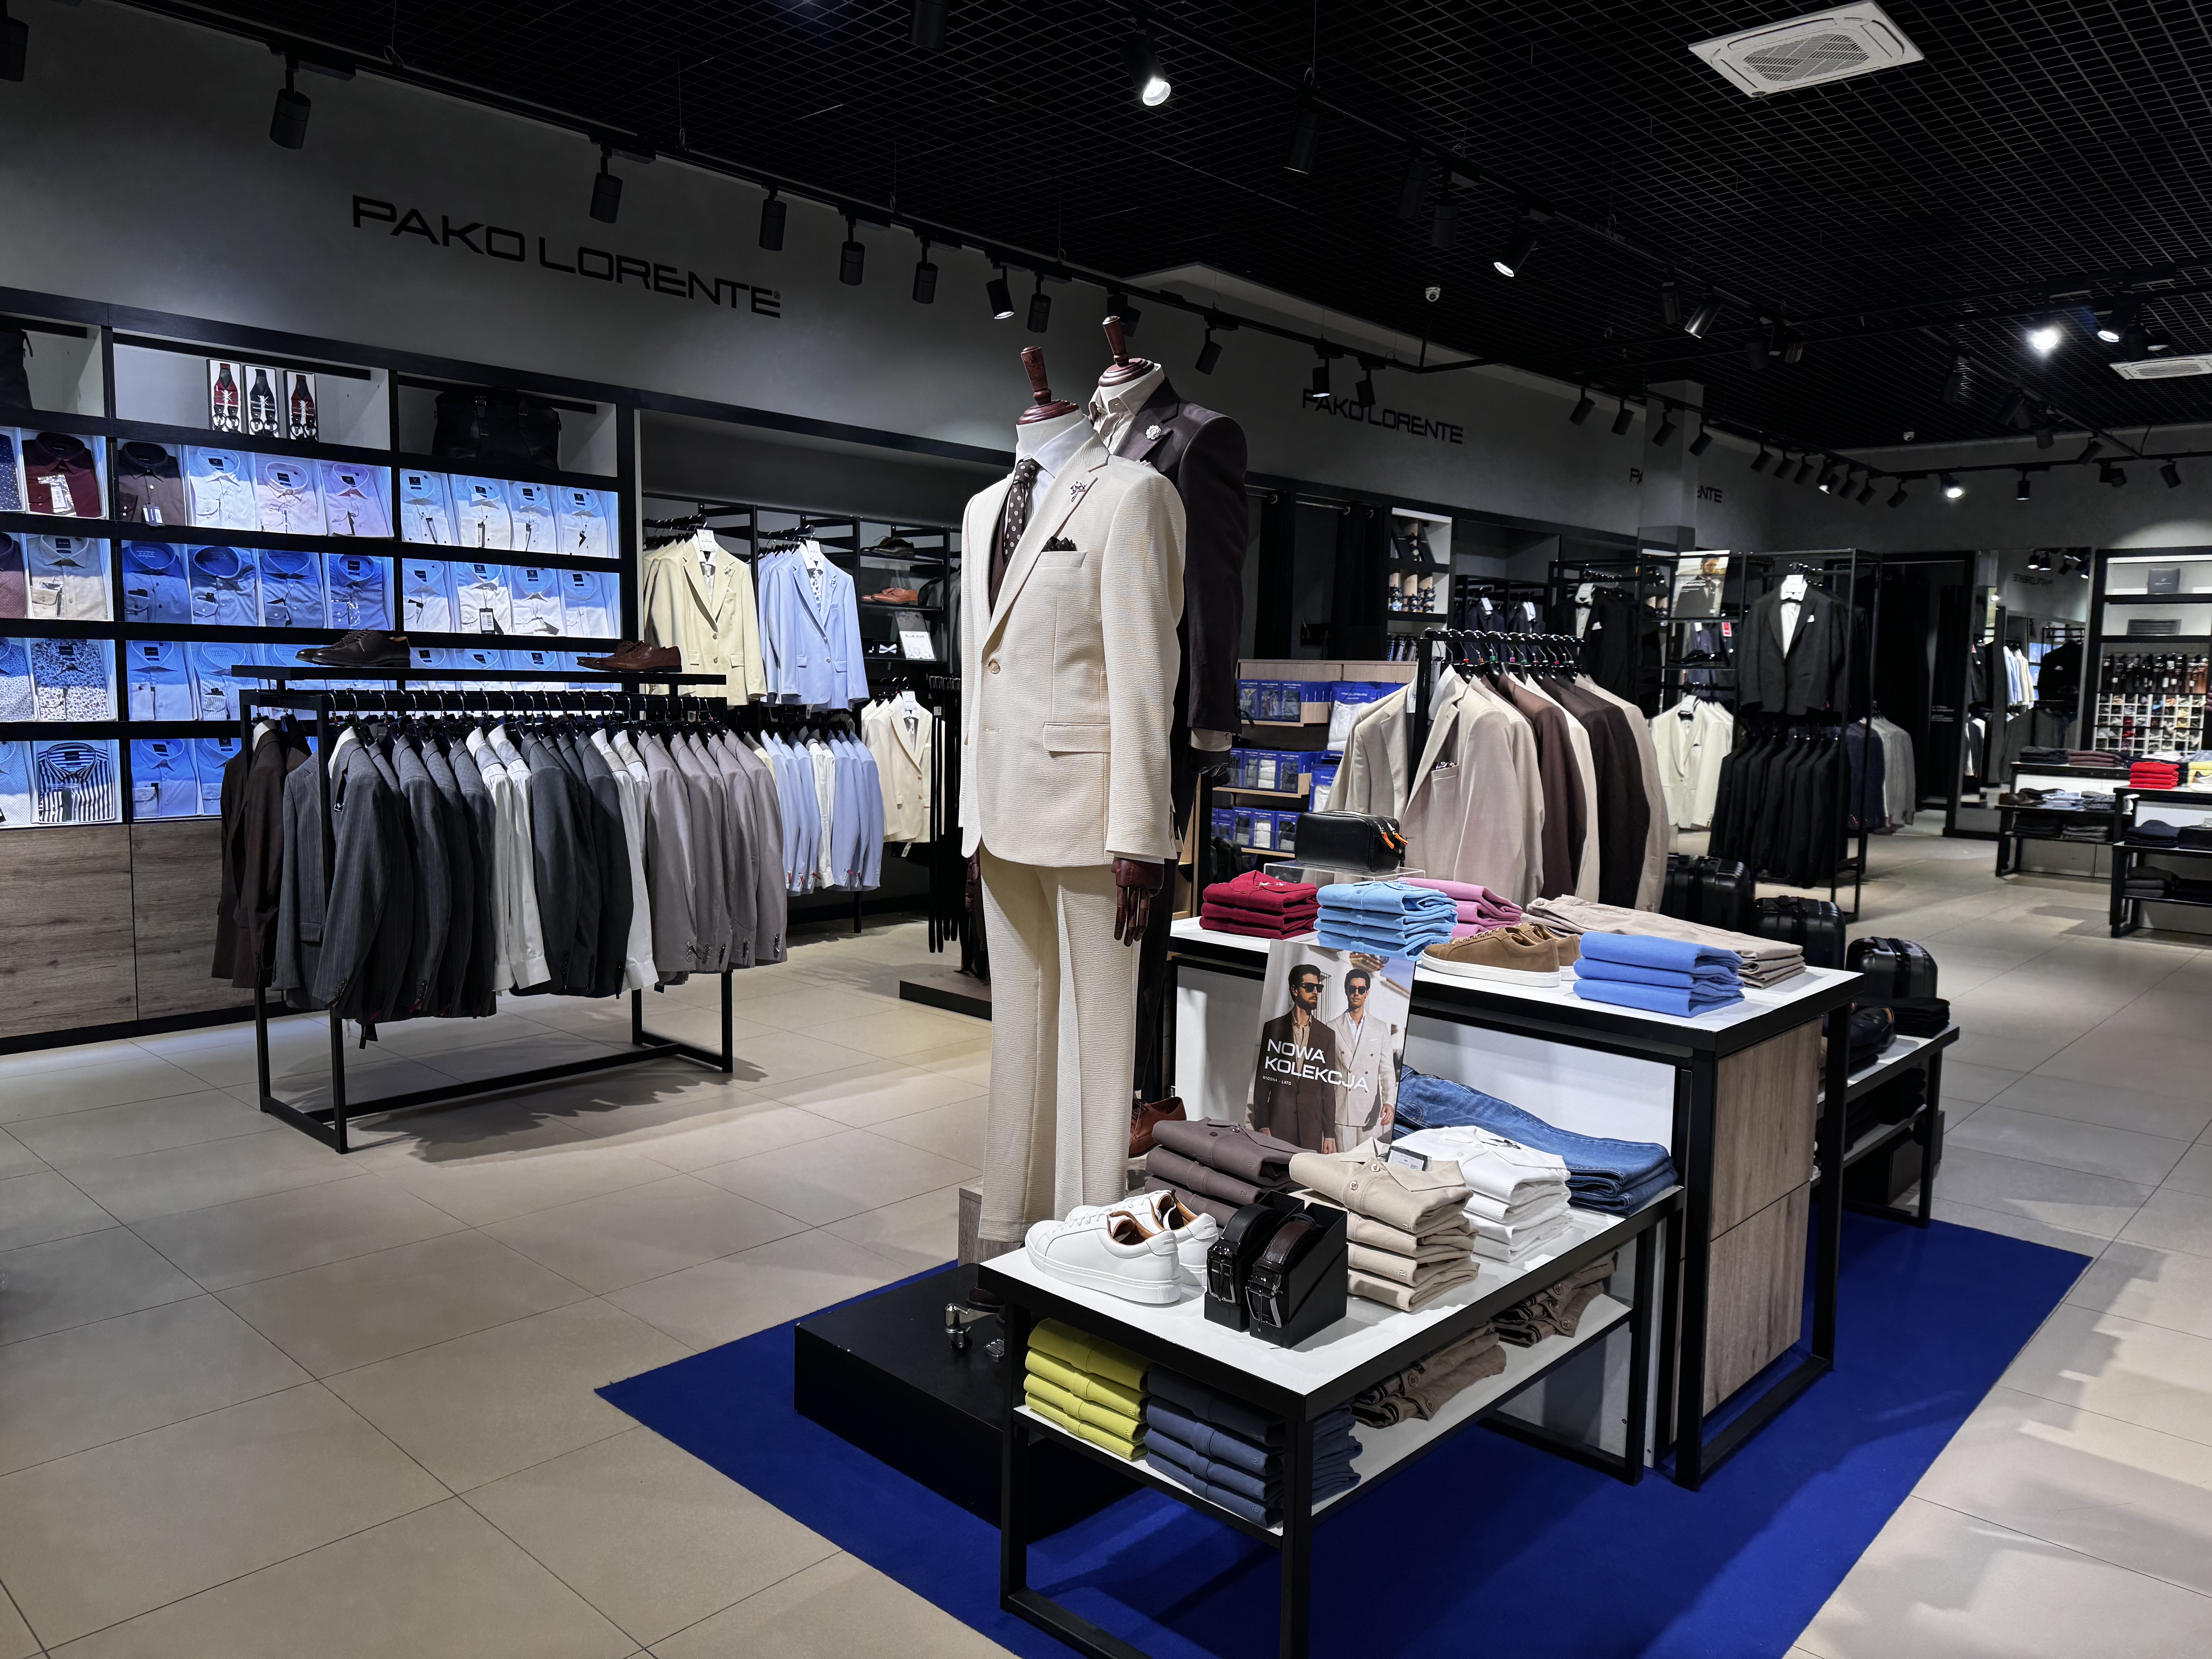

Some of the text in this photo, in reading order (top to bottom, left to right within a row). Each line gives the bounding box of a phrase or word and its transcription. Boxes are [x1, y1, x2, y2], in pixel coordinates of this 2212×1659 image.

[353, 195, 525, 262] PAKO
[1302, 388, 1463, 444] PAKO LORENTE
[1265, 1056, 1369, 1092] KOLEKCJA
[1267, 1039, 1326, 1064] NOWA
